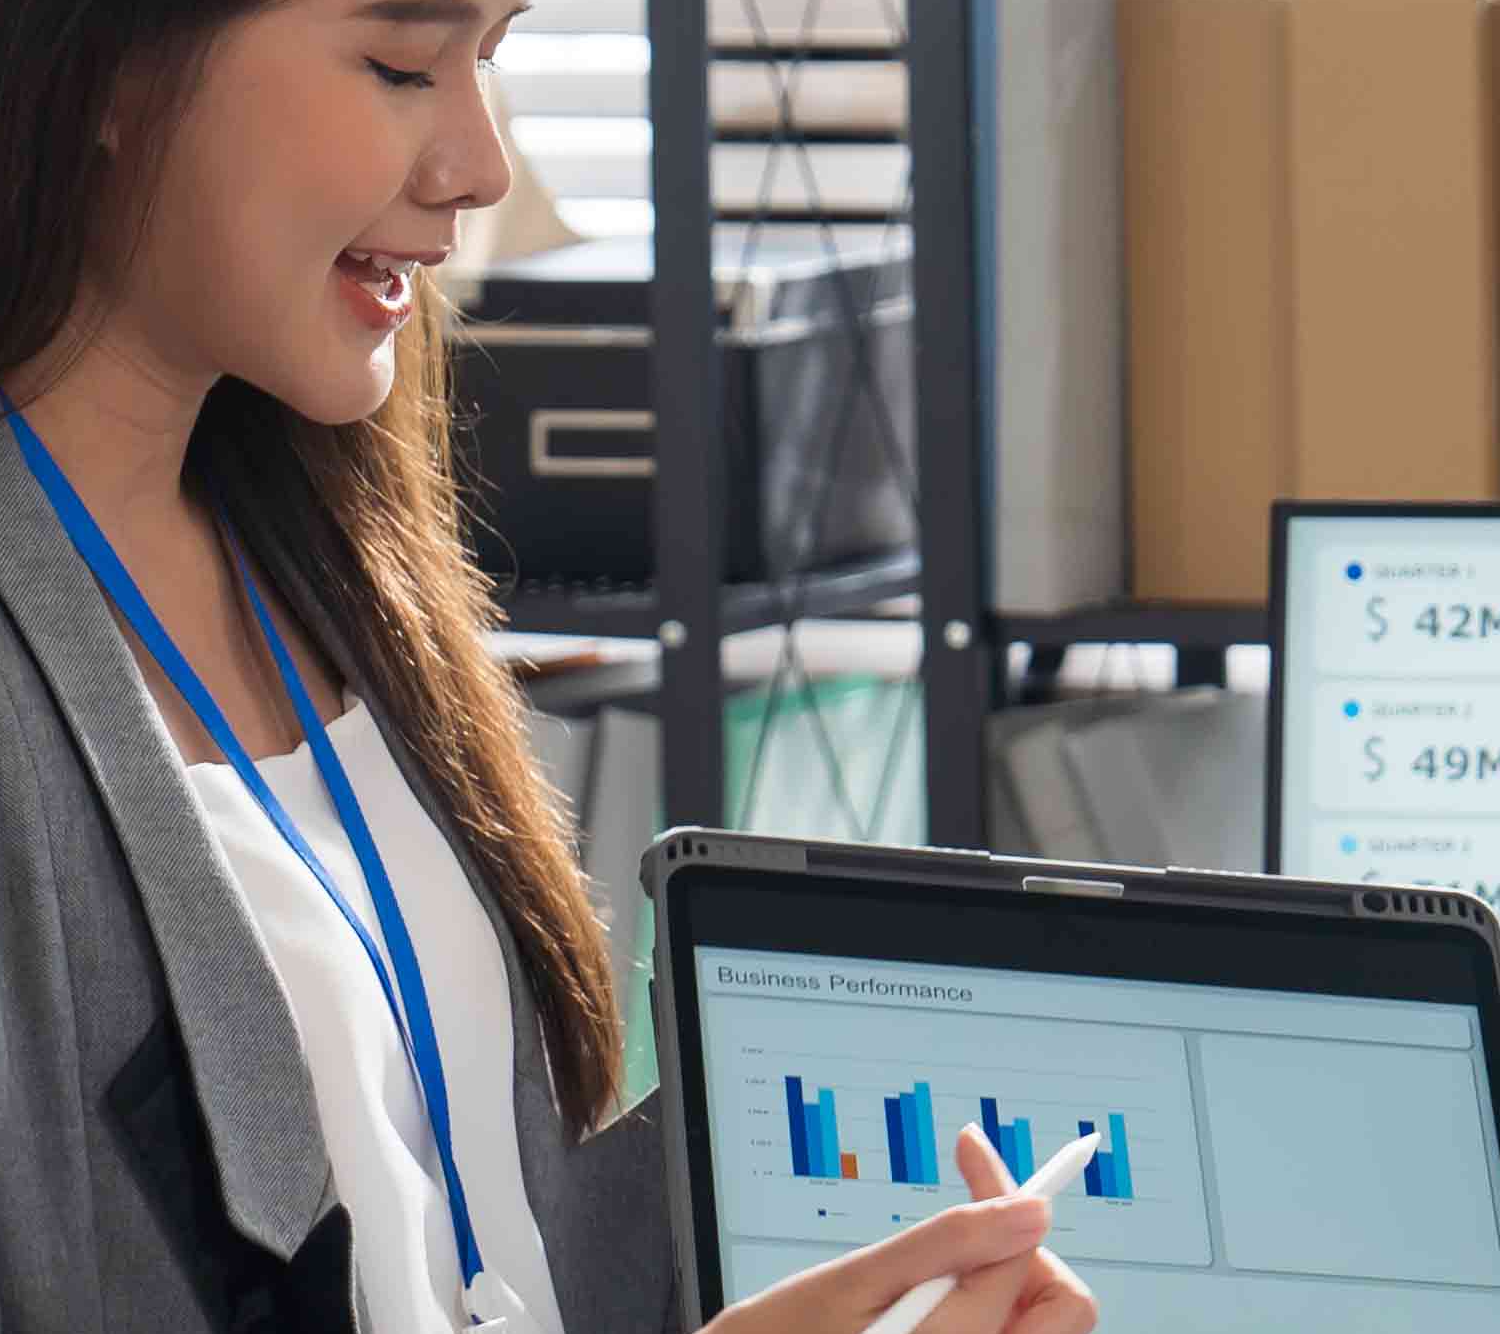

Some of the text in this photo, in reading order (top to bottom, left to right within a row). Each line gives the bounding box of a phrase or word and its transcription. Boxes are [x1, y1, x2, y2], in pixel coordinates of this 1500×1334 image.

[1365, 596, 1389, 642] $
[1363, 735, 1386, 783] $
[717, 966, 974, 1003] Business Performance
